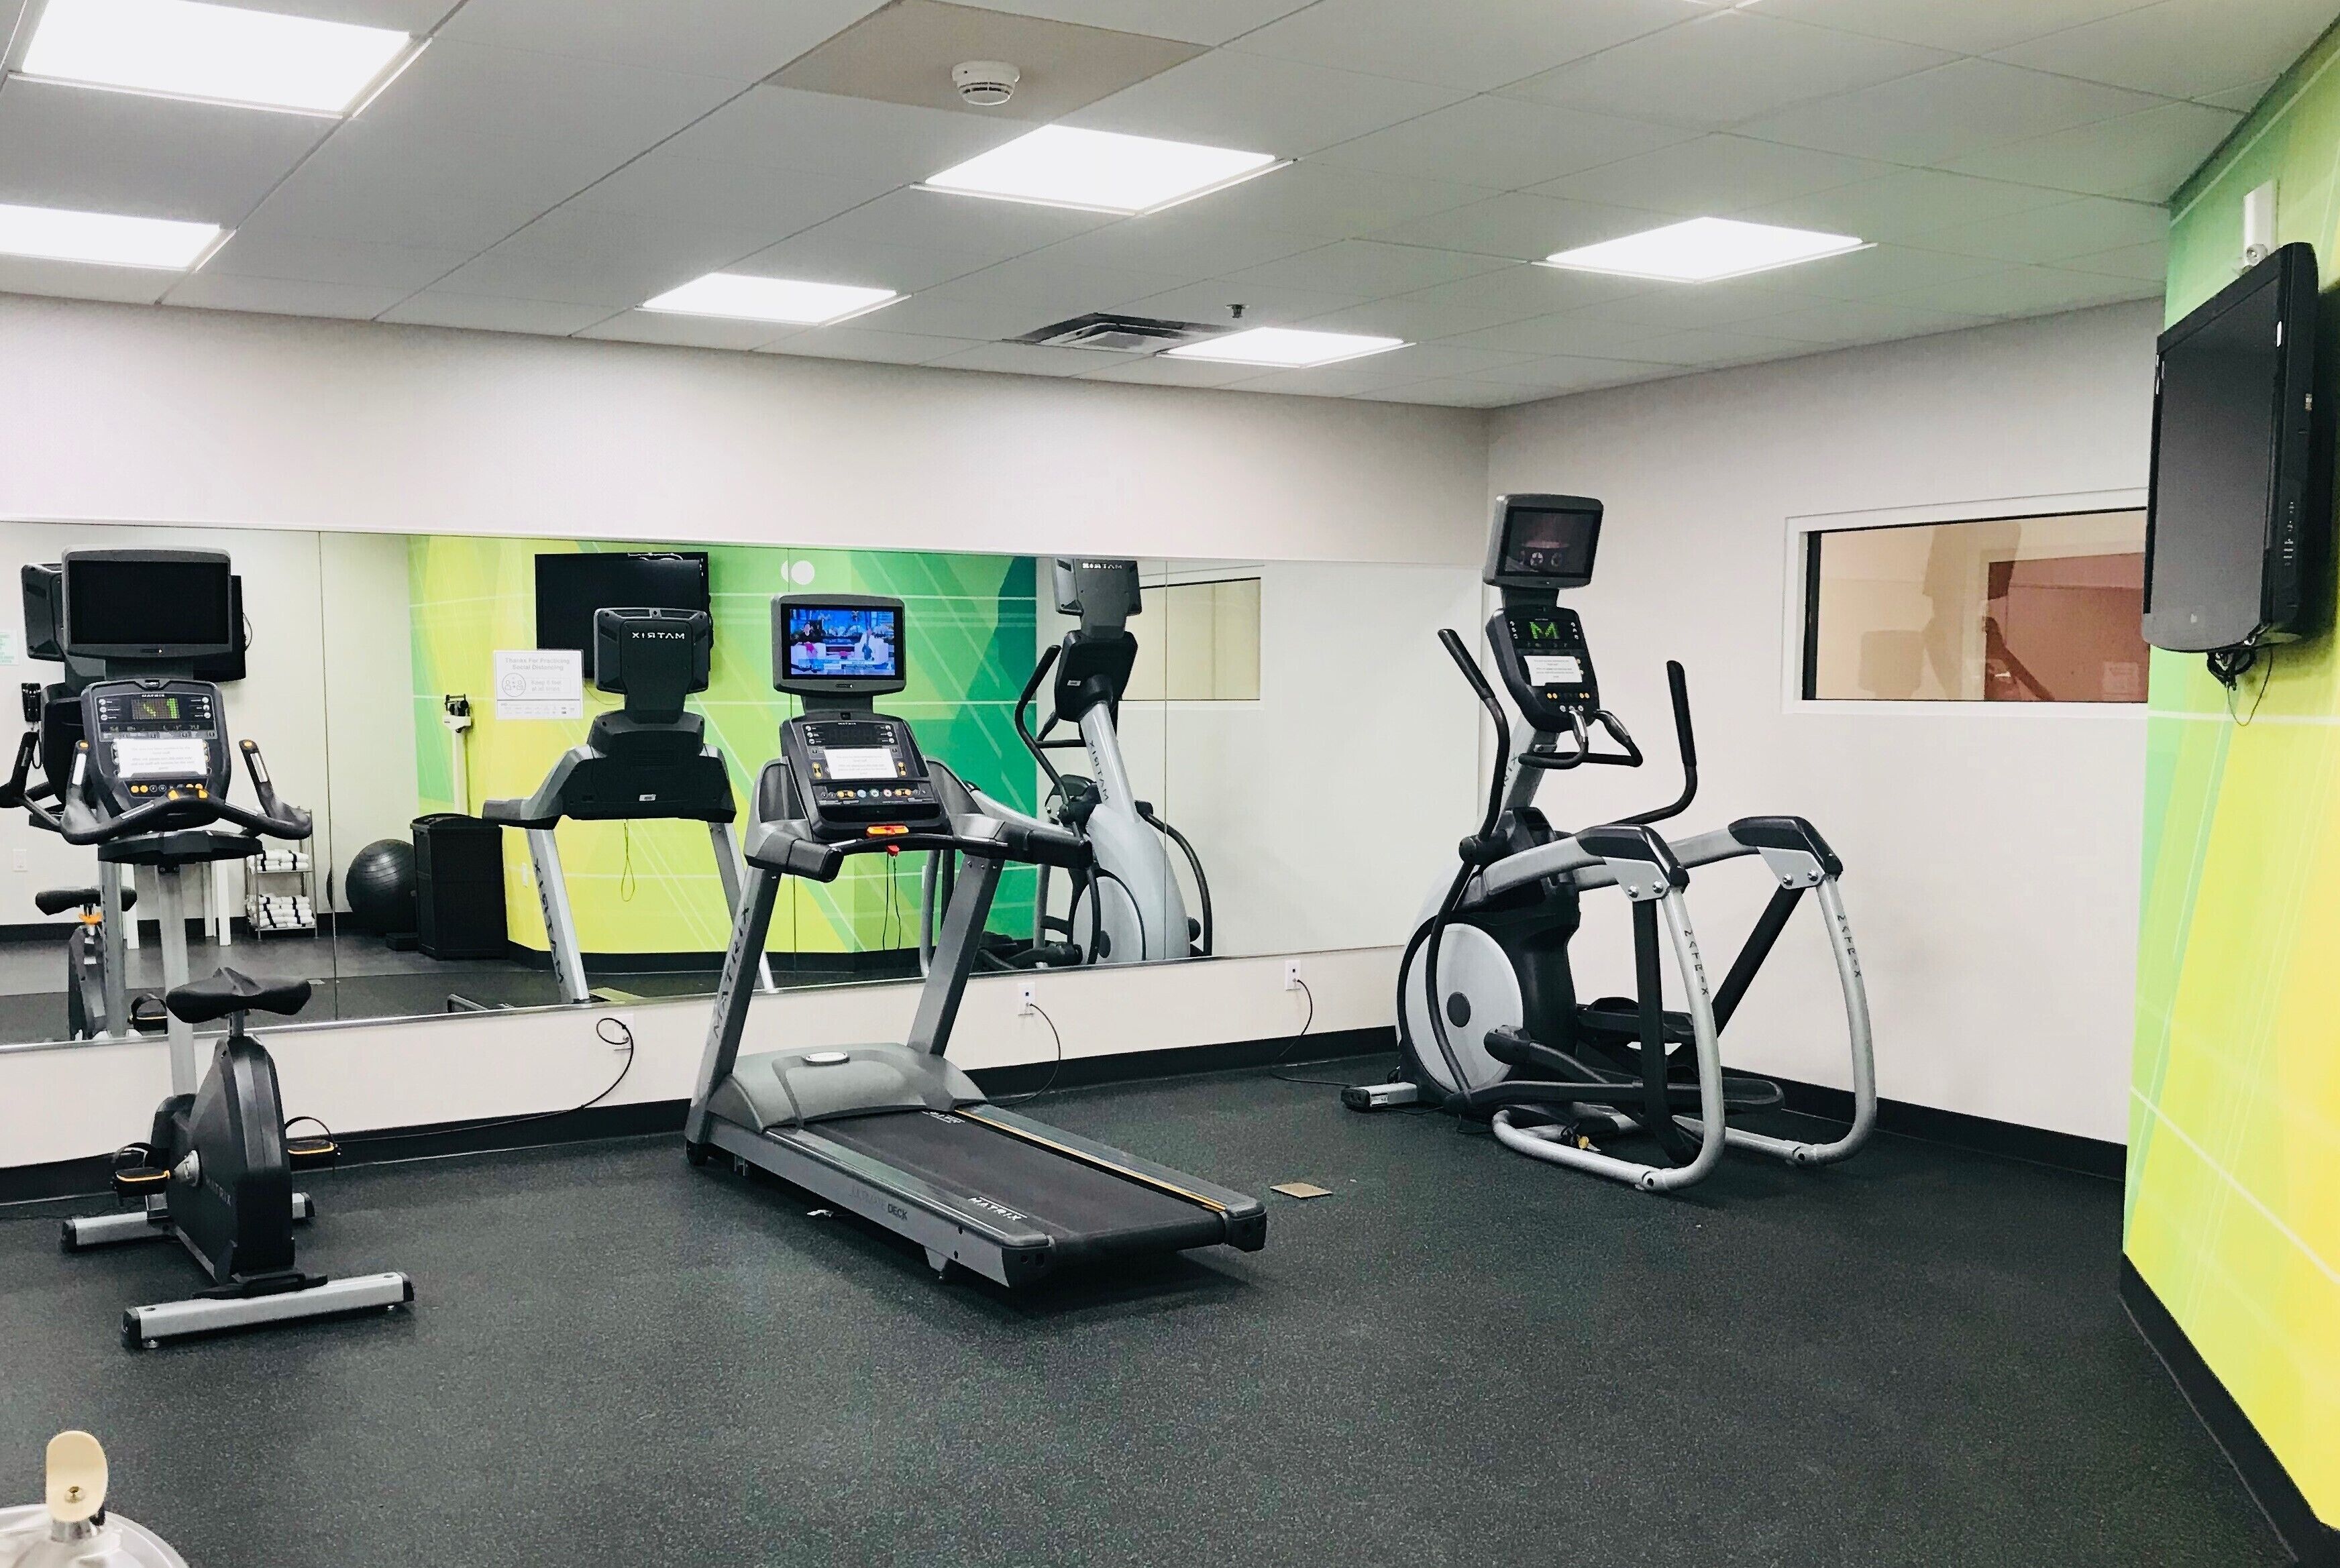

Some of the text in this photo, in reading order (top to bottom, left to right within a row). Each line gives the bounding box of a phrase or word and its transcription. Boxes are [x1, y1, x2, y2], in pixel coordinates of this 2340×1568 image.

[713, 907, 749, 1039] MATRIX
[1684, 930, 1709, 995] MATRIX
[1837, 914, 1862, 978] MATRIX
[888, 1203, 908, 1221] DECK
[968, 1197, 1022, 1221] MATRIX
